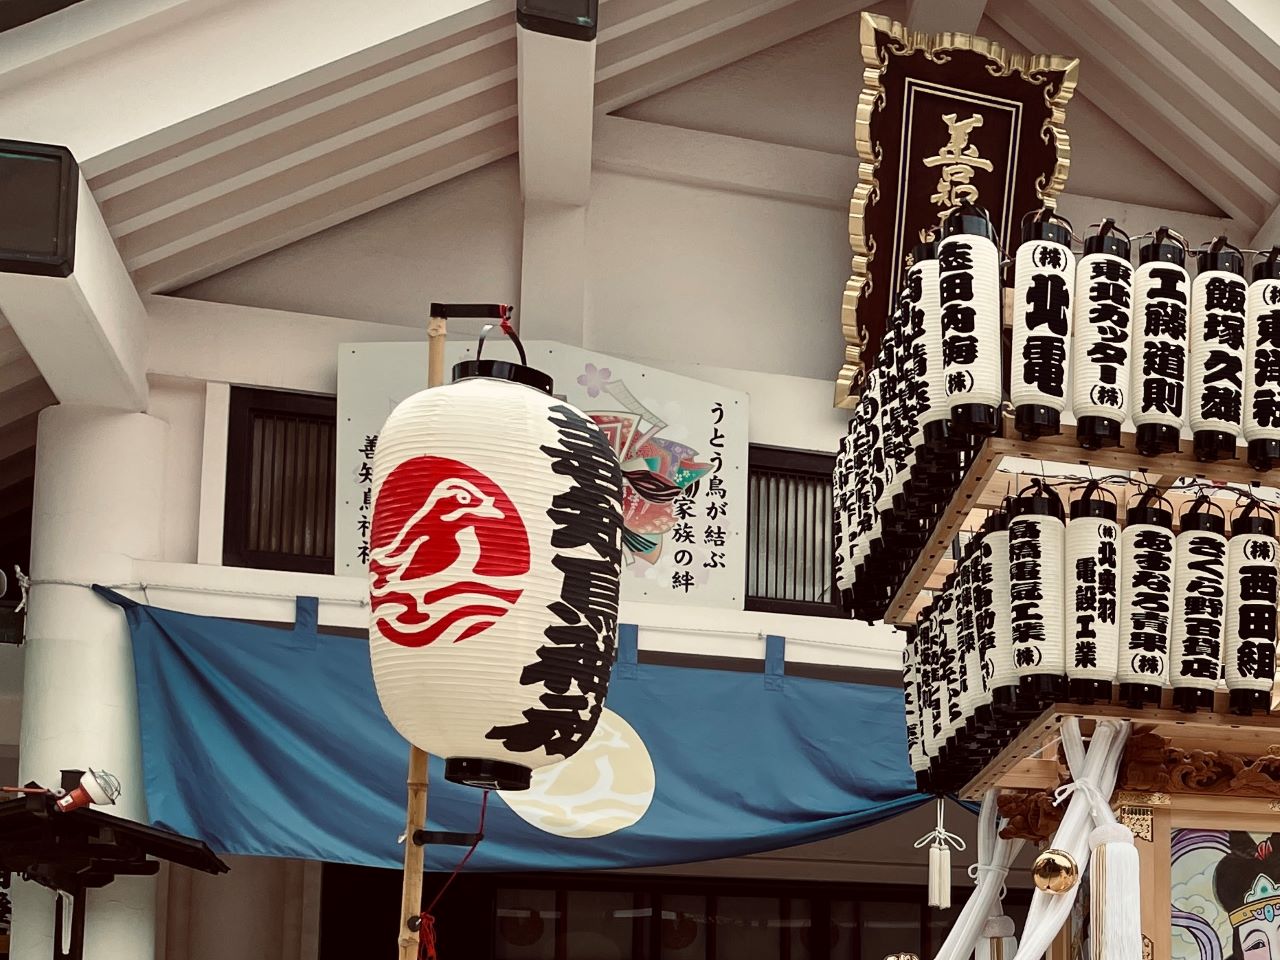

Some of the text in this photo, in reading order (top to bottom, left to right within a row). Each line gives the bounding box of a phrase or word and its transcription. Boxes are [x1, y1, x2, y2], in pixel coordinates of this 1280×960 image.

[1022, 245, 1069, 397] (株)北電
[1087, 259, 1131, 409] 東北カッター(株)
[1141, 267, 1187, 418] 工藤道則
[671, 495, 697, 592] 家族の絆
[703, 401, 727, 569] うとう鳥が結ぶ
[1180, 536, 1226, 680] さくら野百貨店
[1237, 538, 1278, 681] (株)西田組
